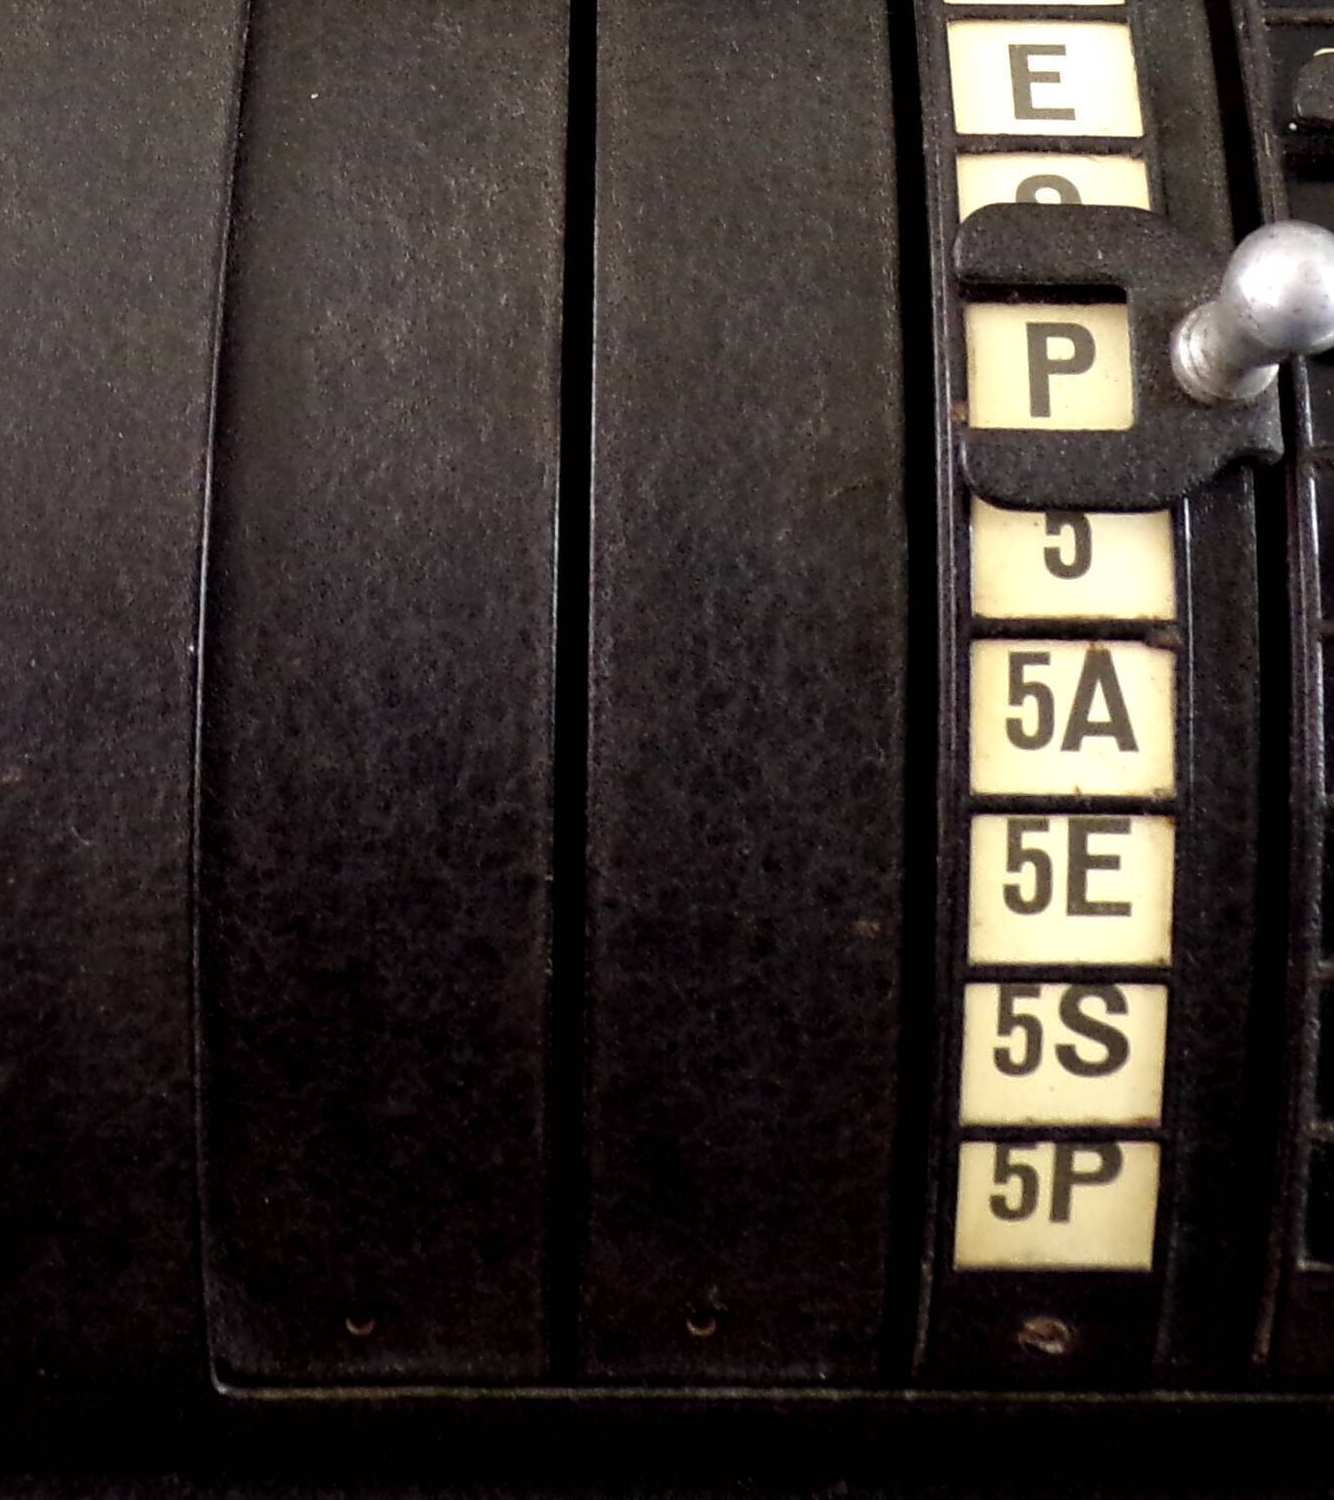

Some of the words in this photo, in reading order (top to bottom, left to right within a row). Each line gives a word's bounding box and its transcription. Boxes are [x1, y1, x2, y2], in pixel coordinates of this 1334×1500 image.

[1008, 43, 1077, 122] E
[1025, 320, 1097, 418] P
[1043, 512, 1095, 580] 5
[1003, 650, 1140, 753] 5A
[1002, 817, 1133, 917] 5E
[992, 984, 1131, 1077] 5S
[988, 1142, 1124, 1223] 5P
